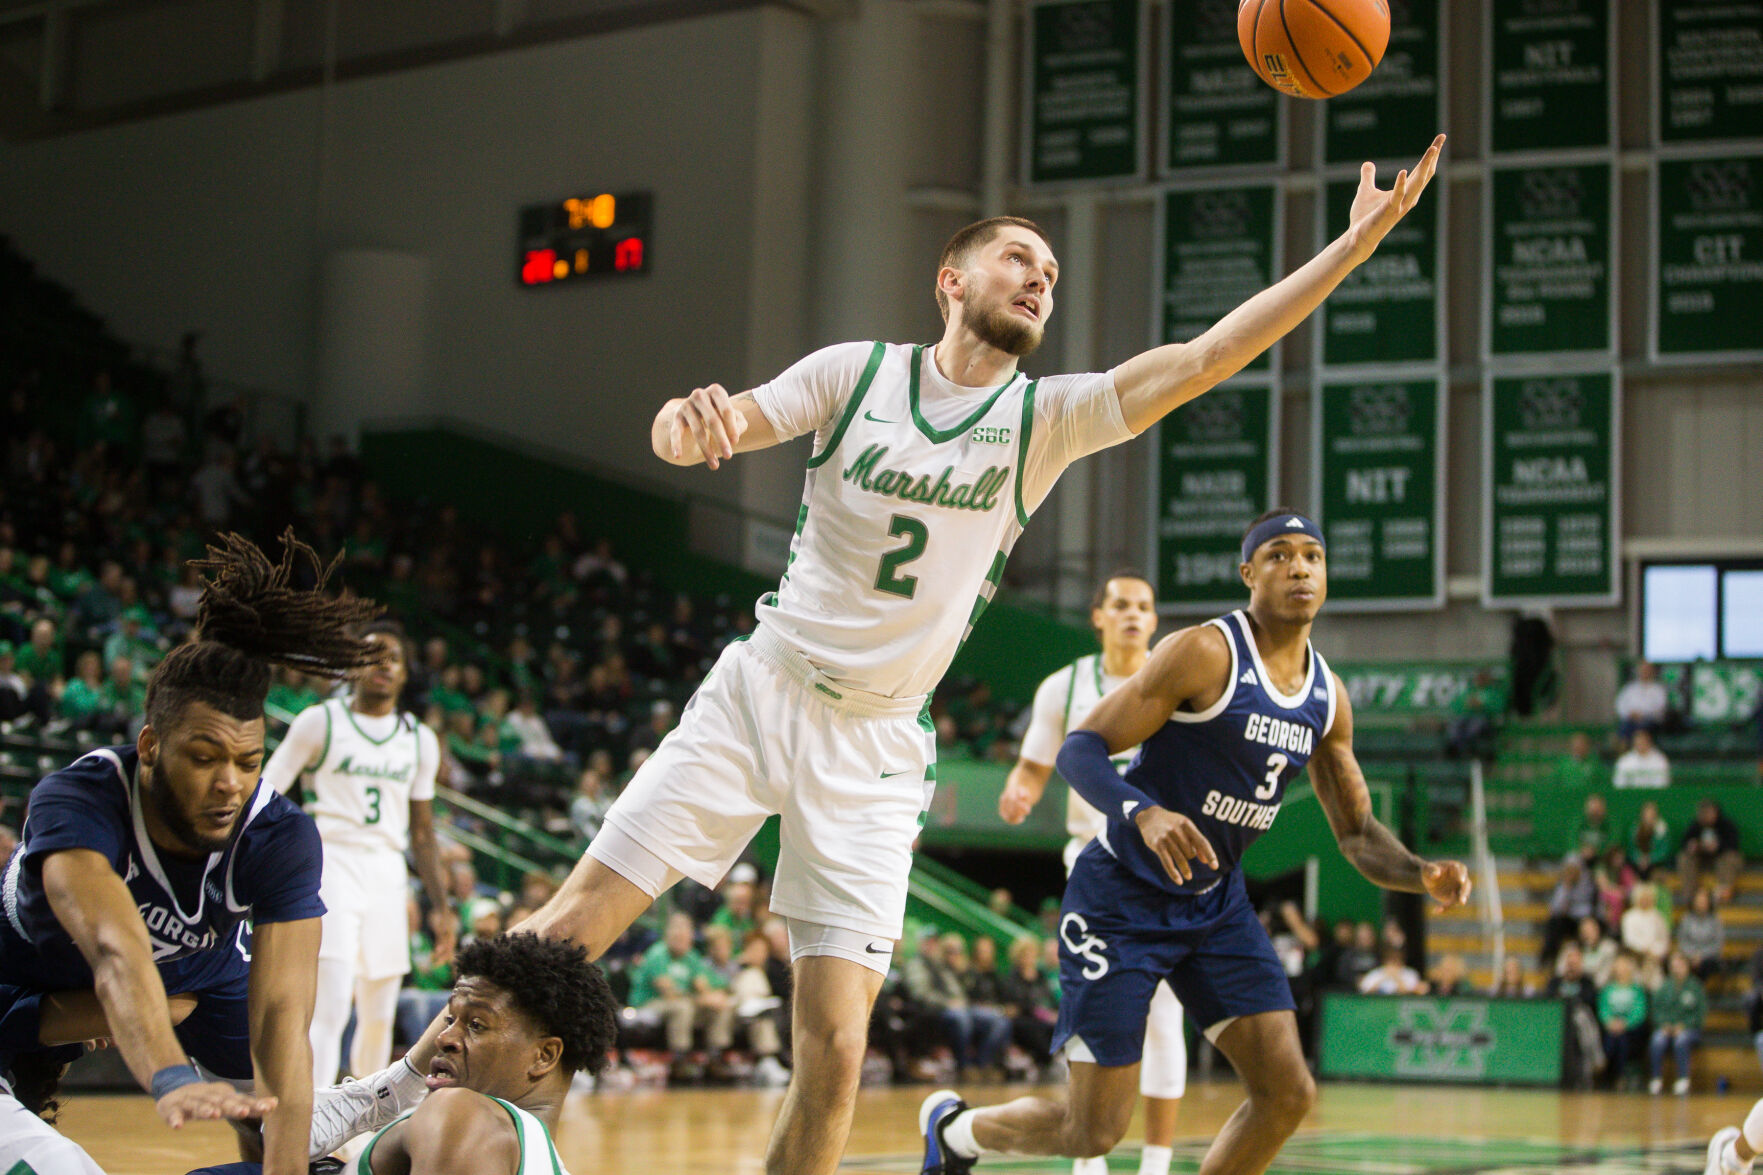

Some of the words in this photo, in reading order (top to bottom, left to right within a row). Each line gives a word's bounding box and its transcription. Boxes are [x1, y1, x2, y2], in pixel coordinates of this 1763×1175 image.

[972, 427, 1011, 444] SBC
[842, 443, 1010, 512] Marshall
[1346, 467, 1410, 502] NIT
[1513, 457, 1587, 483] NCAA
[873, 513, 930, 600] 2
[1244, 713, 1313, 756] GEORGIA
[1255, 752, 1288, 800] 3
[364, 786, 382, 825] 3
